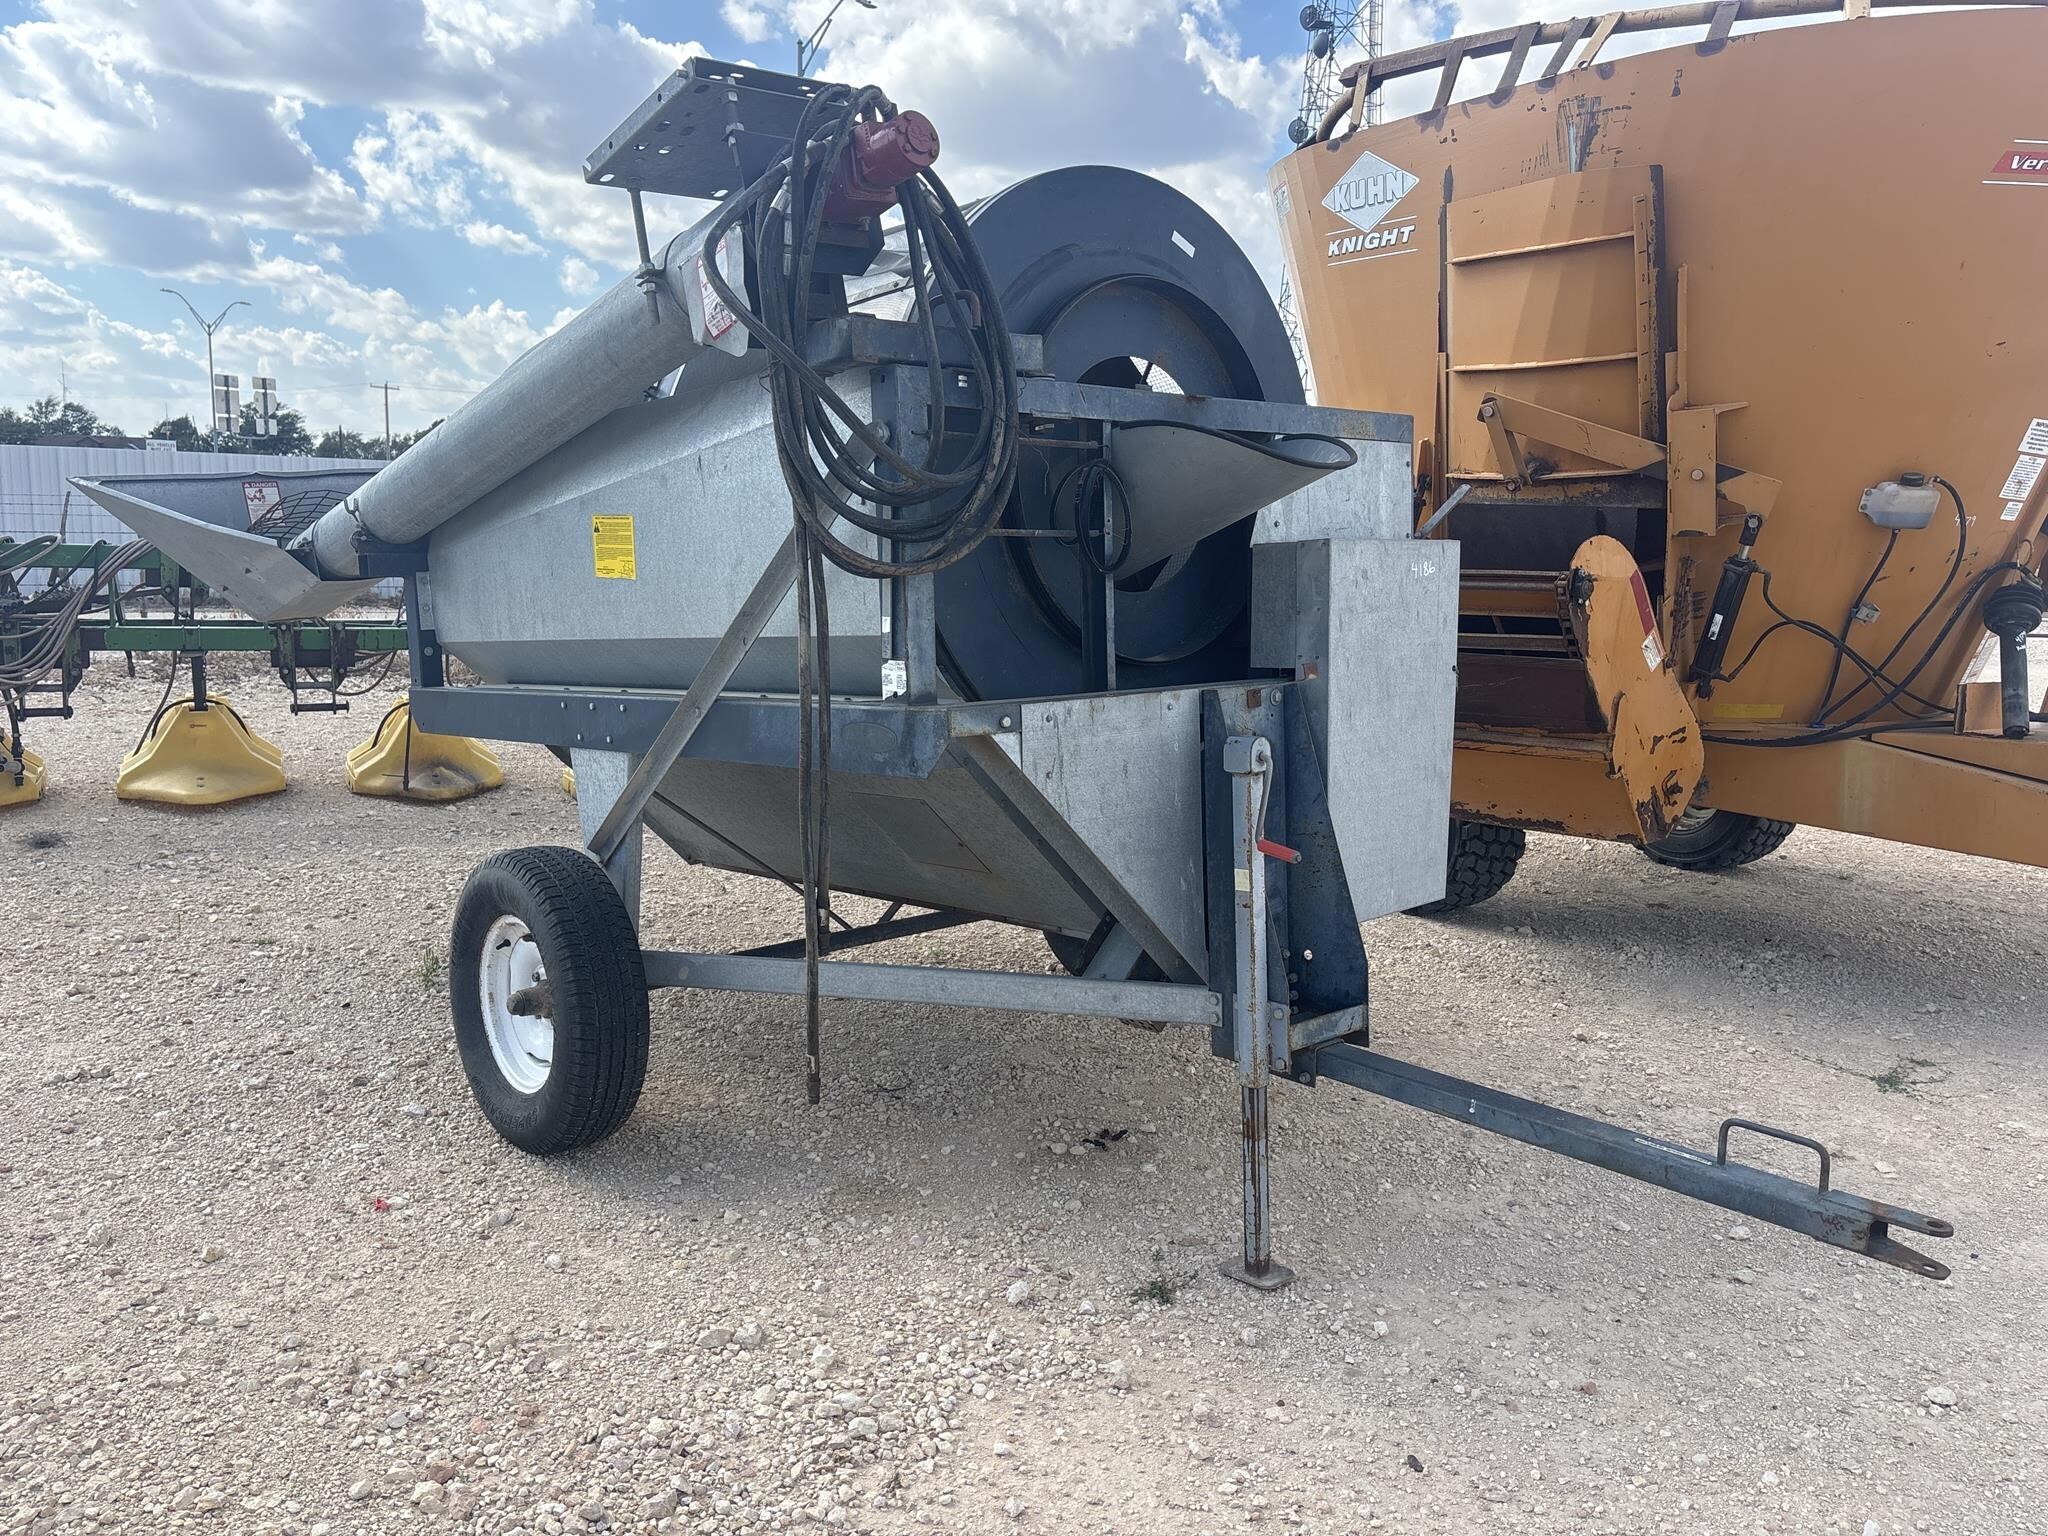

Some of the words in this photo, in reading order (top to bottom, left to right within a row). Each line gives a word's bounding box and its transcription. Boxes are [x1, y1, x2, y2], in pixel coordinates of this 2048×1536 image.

[2010, 155, 2048, 171] Ver
[1333, 170, 1404, 213] KUHN
[1328, 225, 1416, 257] KNIGHT
[1955, 513, 1977, 528] 479
[1411, 560, 1436, 579] 4186
